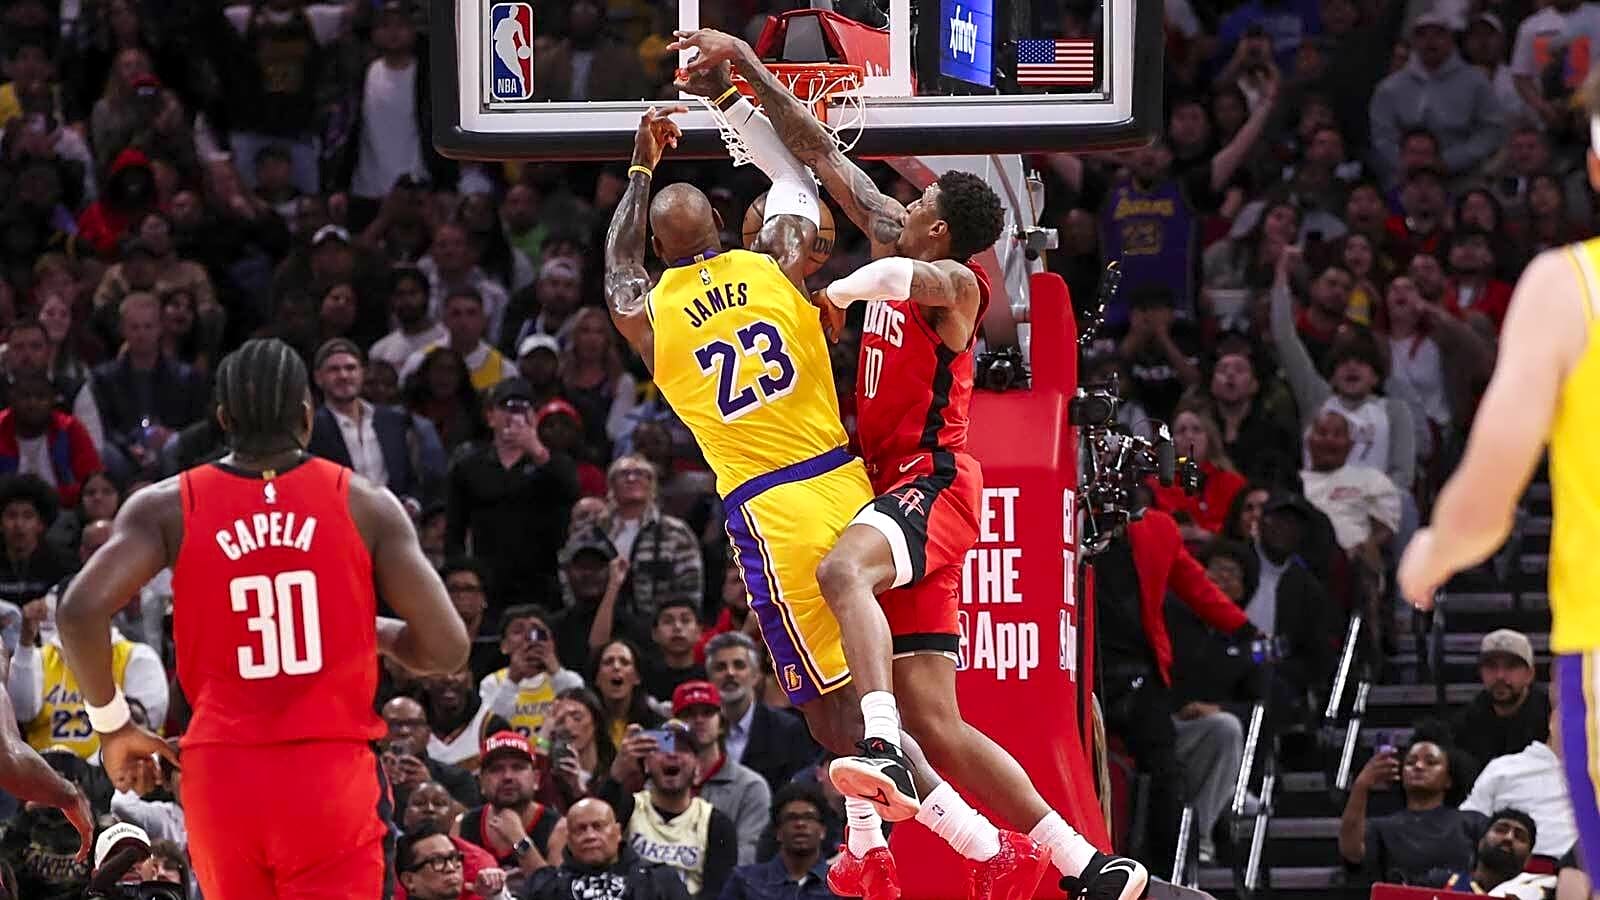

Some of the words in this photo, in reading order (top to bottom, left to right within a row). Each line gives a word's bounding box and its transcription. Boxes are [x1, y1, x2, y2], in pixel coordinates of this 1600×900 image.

[949, 4, 978, 63] xfinity
[497, 78, 517, 94] NBA
[683, 282, 748, 329] JAMES
[694, 319, 798, 423] 23
[864, 345, 884, 399] 10
[215, 511, 318, 561] CAPELA
[976, 488, 1021, 543] ET
[962, 548, 1022, 604] THE
[229, 569, 323, 680] 30
[974, 611, 1039, 680] App
[52, 709, 94, 738] 23
[631, 833, 698, 866] LAKERS
